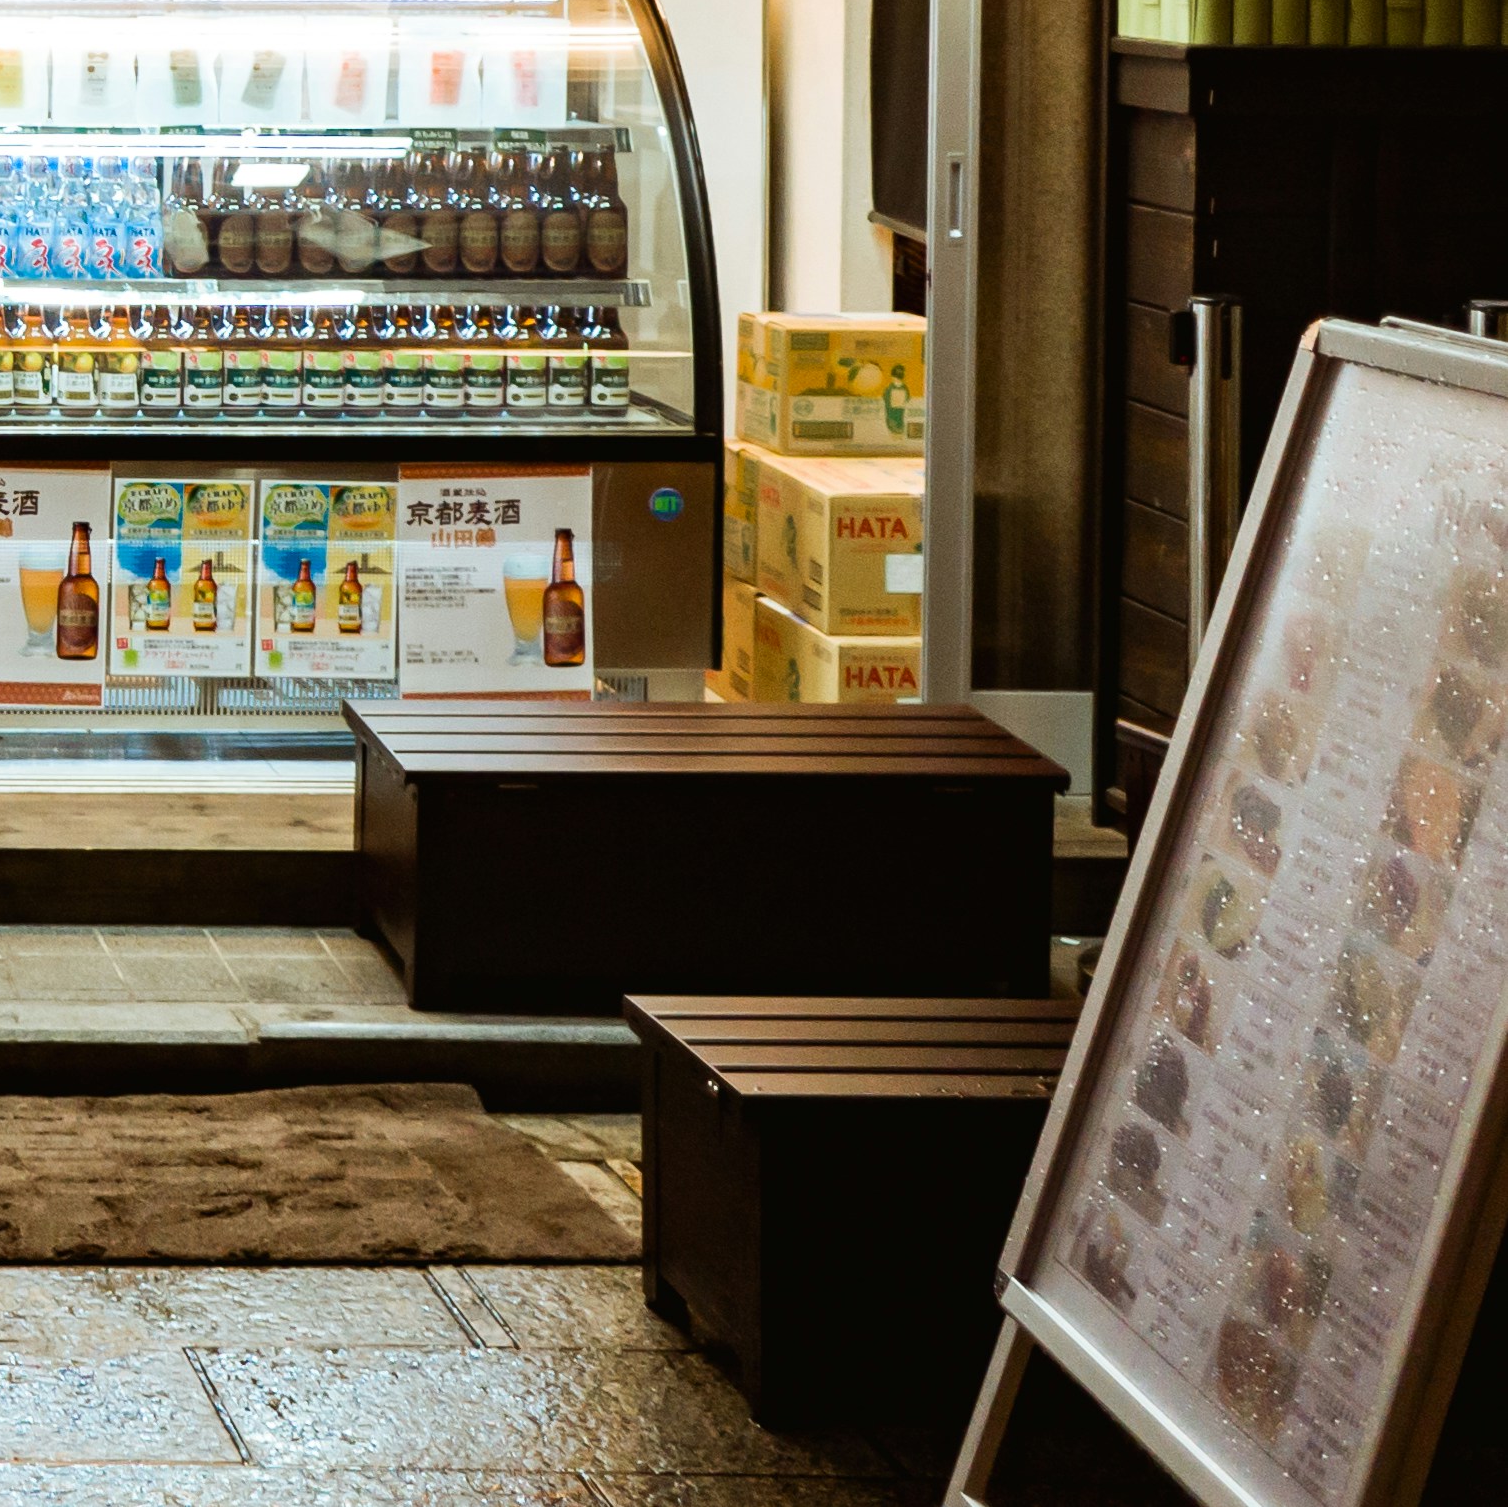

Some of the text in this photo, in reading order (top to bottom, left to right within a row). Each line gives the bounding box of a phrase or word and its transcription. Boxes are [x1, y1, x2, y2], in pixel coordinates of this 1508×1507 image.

[406, 499, 521, 527] 京都麦酒
[837, 516, 909, 540] HATA
[845, 666, 917, 689] HATA
